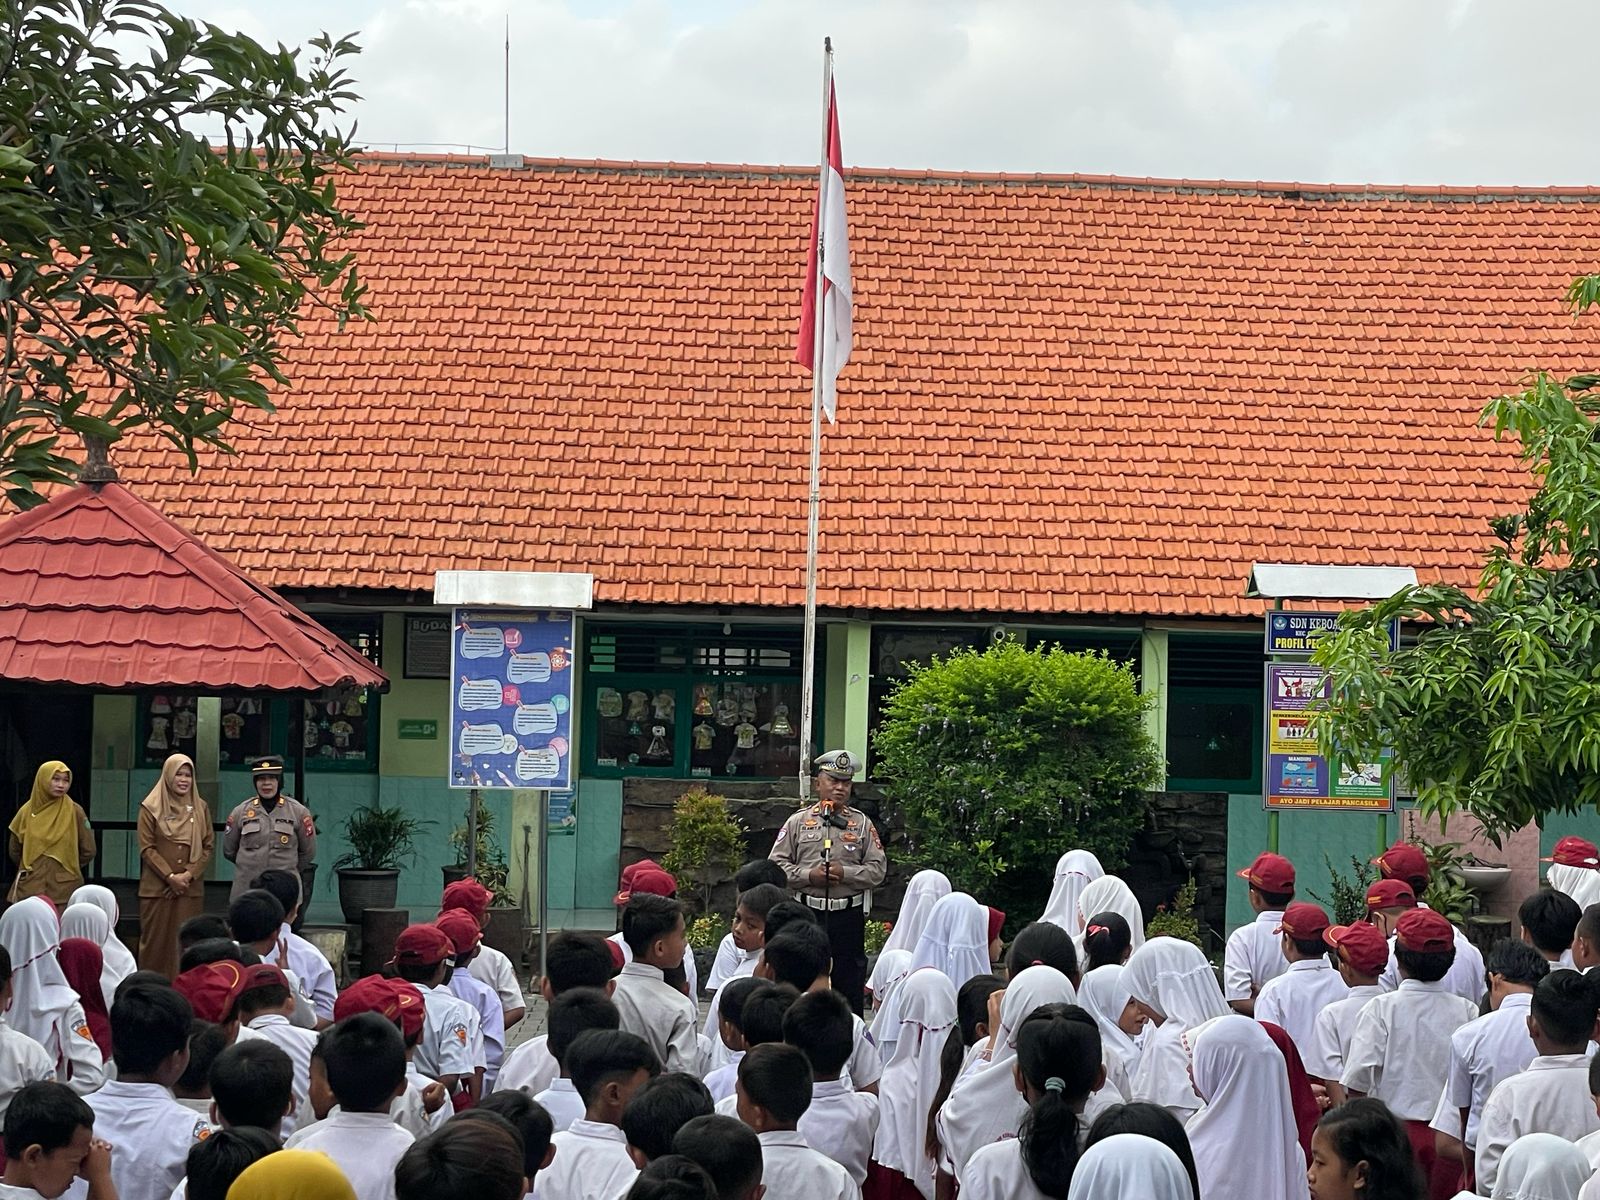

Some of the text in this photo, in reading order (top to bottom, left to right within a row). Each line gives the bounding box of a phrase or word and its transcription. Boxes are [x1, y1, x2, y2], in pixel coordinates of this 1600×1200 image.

[1290, 617, 1307, 629] SDN
[1275, 637, 1304, 649] PROFIL
[1342, 799, 1379, 807] PANCASILA
